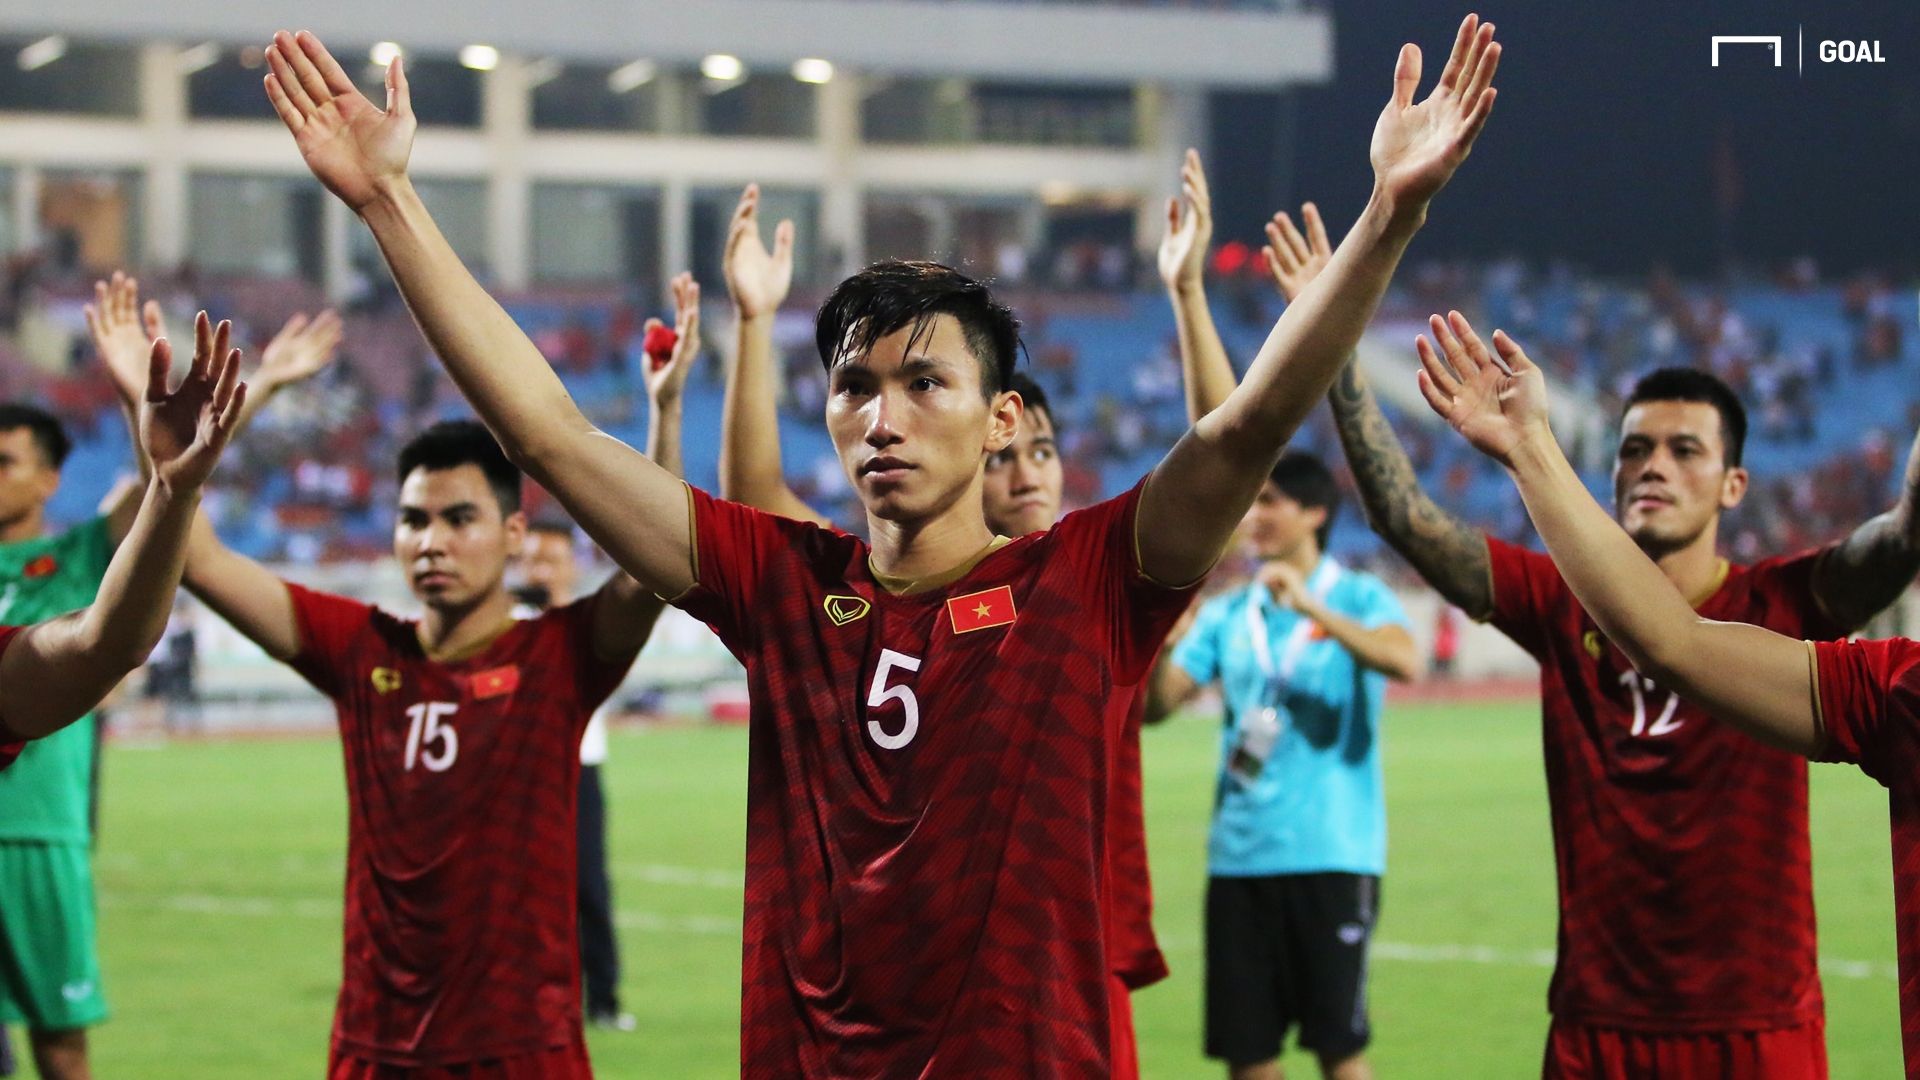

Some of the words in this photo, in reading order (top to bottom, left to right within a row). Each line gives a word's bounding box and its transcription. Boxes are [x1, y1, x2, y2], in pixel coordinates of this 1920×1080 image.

[867, 648, 921, 750] 5
[1619, 668, 1685, 736] 12
[404, 701, 459, 773] 15
